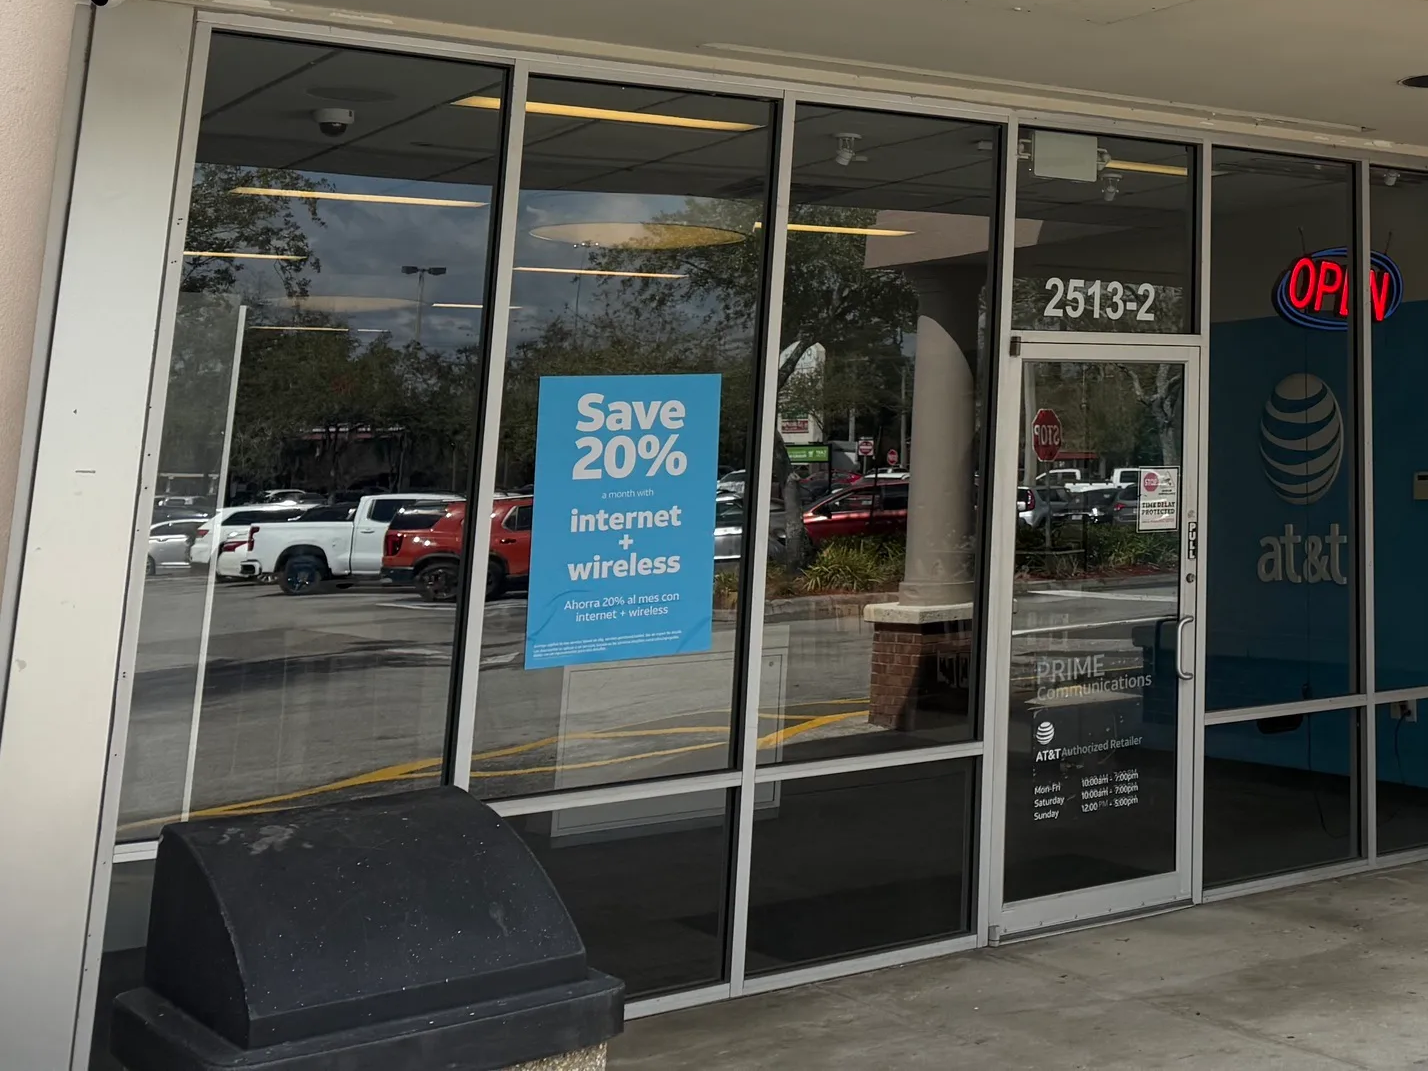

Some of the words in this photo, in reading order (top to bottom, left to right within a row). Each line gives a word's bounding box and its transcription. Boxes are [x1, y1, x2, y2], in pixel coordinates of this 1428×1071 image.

[1043, 277, 1156, 321] 2513-2
[575, 393, 686, 432] Save
[572, 434, 688, 480] 20%
[601, 491, 607, 499] a
[608, 489, 636, 498] month
[637, 488, 654, 497] with
[570, 505, 682, 533] internet
[618, 534, 634, 550] +
[1188, 522, 1197, 559] PULL
[1257, 523, 1347, 585] at&t
[567, 552, 681, 581] wireless
[564, 599, 600, 610] Ahorra
[602, 596, 625, 607] 20%
[627, 594, 636, 605] al
[638, 594, 659, 603] mes
[661, 592, 680, 602] con
[575, 610, 617, 622] internet
[629, 605, 668, 618] wireless
[1036, 654, 1105, 685] PRIME
[1037, 674, 1152, 701] Communications
[1035, 749, 1061, 762] AT&T
[1061, 739, 1109, 757] Authorized
[1110, 736, 1142, 749] Retailer
[1034, 782, 1061, 795] Mon-Fri
[1034, 796, 1065, 808] Saturday
[1033, 810, 1060, 821] Sunday
